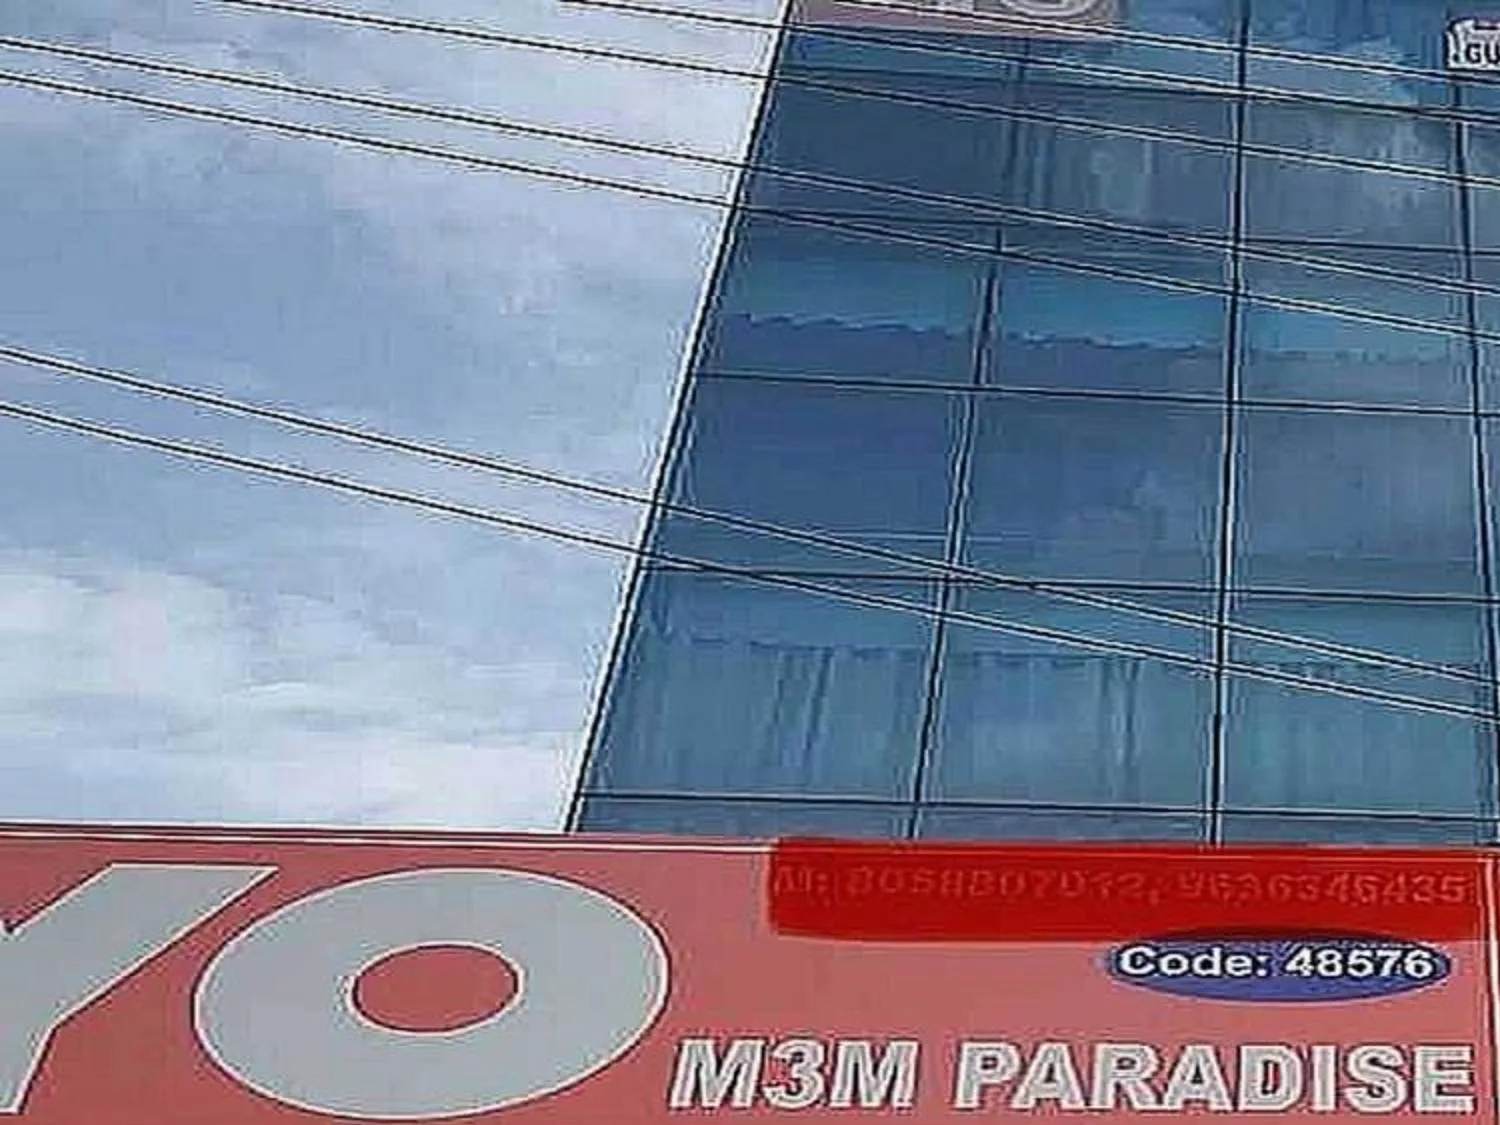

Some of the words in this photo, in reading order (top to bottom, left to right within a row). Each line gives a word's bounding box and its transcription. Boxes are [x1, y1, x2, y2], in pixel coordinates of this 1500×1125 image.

[1119, 945, 1269, 978] Code:
[1285, 945, 1434, 978] 48576
[667, 1037, 920, 1111] M3M
[954, 1041, 1476, 1113] PARADISE
